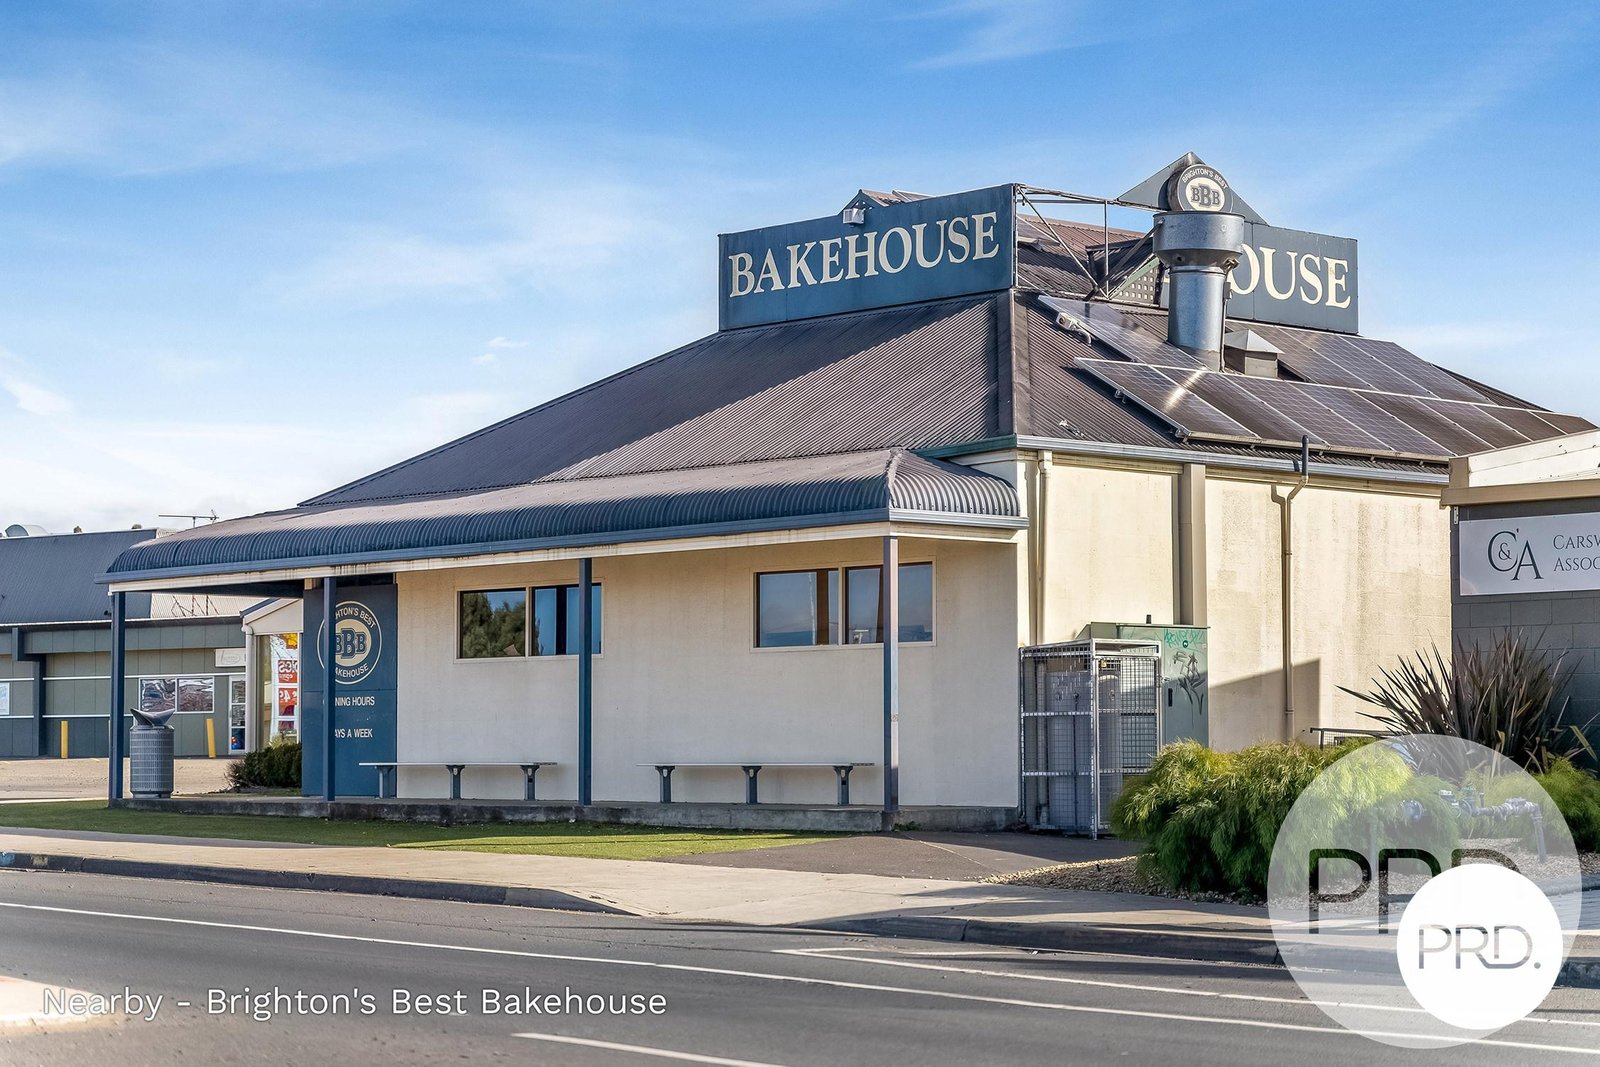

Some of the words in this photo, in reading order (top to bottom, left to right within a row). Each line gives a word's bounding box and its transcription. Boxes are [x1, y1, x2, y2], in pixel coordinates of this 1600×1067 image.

[1182, 168, 1213, 183] BRIGHTON'S
[1214, 173, 1228, 189] BEST
[1190, 183, 1220, 208] BBB
[728, 211, 999, 298] BAKEHOUSE
[1228, 243, 1351, 309] OUSE
[335, 607, 359, 620] HTON'S
[360, 610, 376, 628] BEST
[335, 663, 369, 678] AKEHOUSE
[335, 696, 351, 706] NING
[352, 696, 375, 706] HOURS
[335, 728, 346, 738] AYS
[346, 728, 352, 738] A
[353, 728, 373, 738] WEEK
